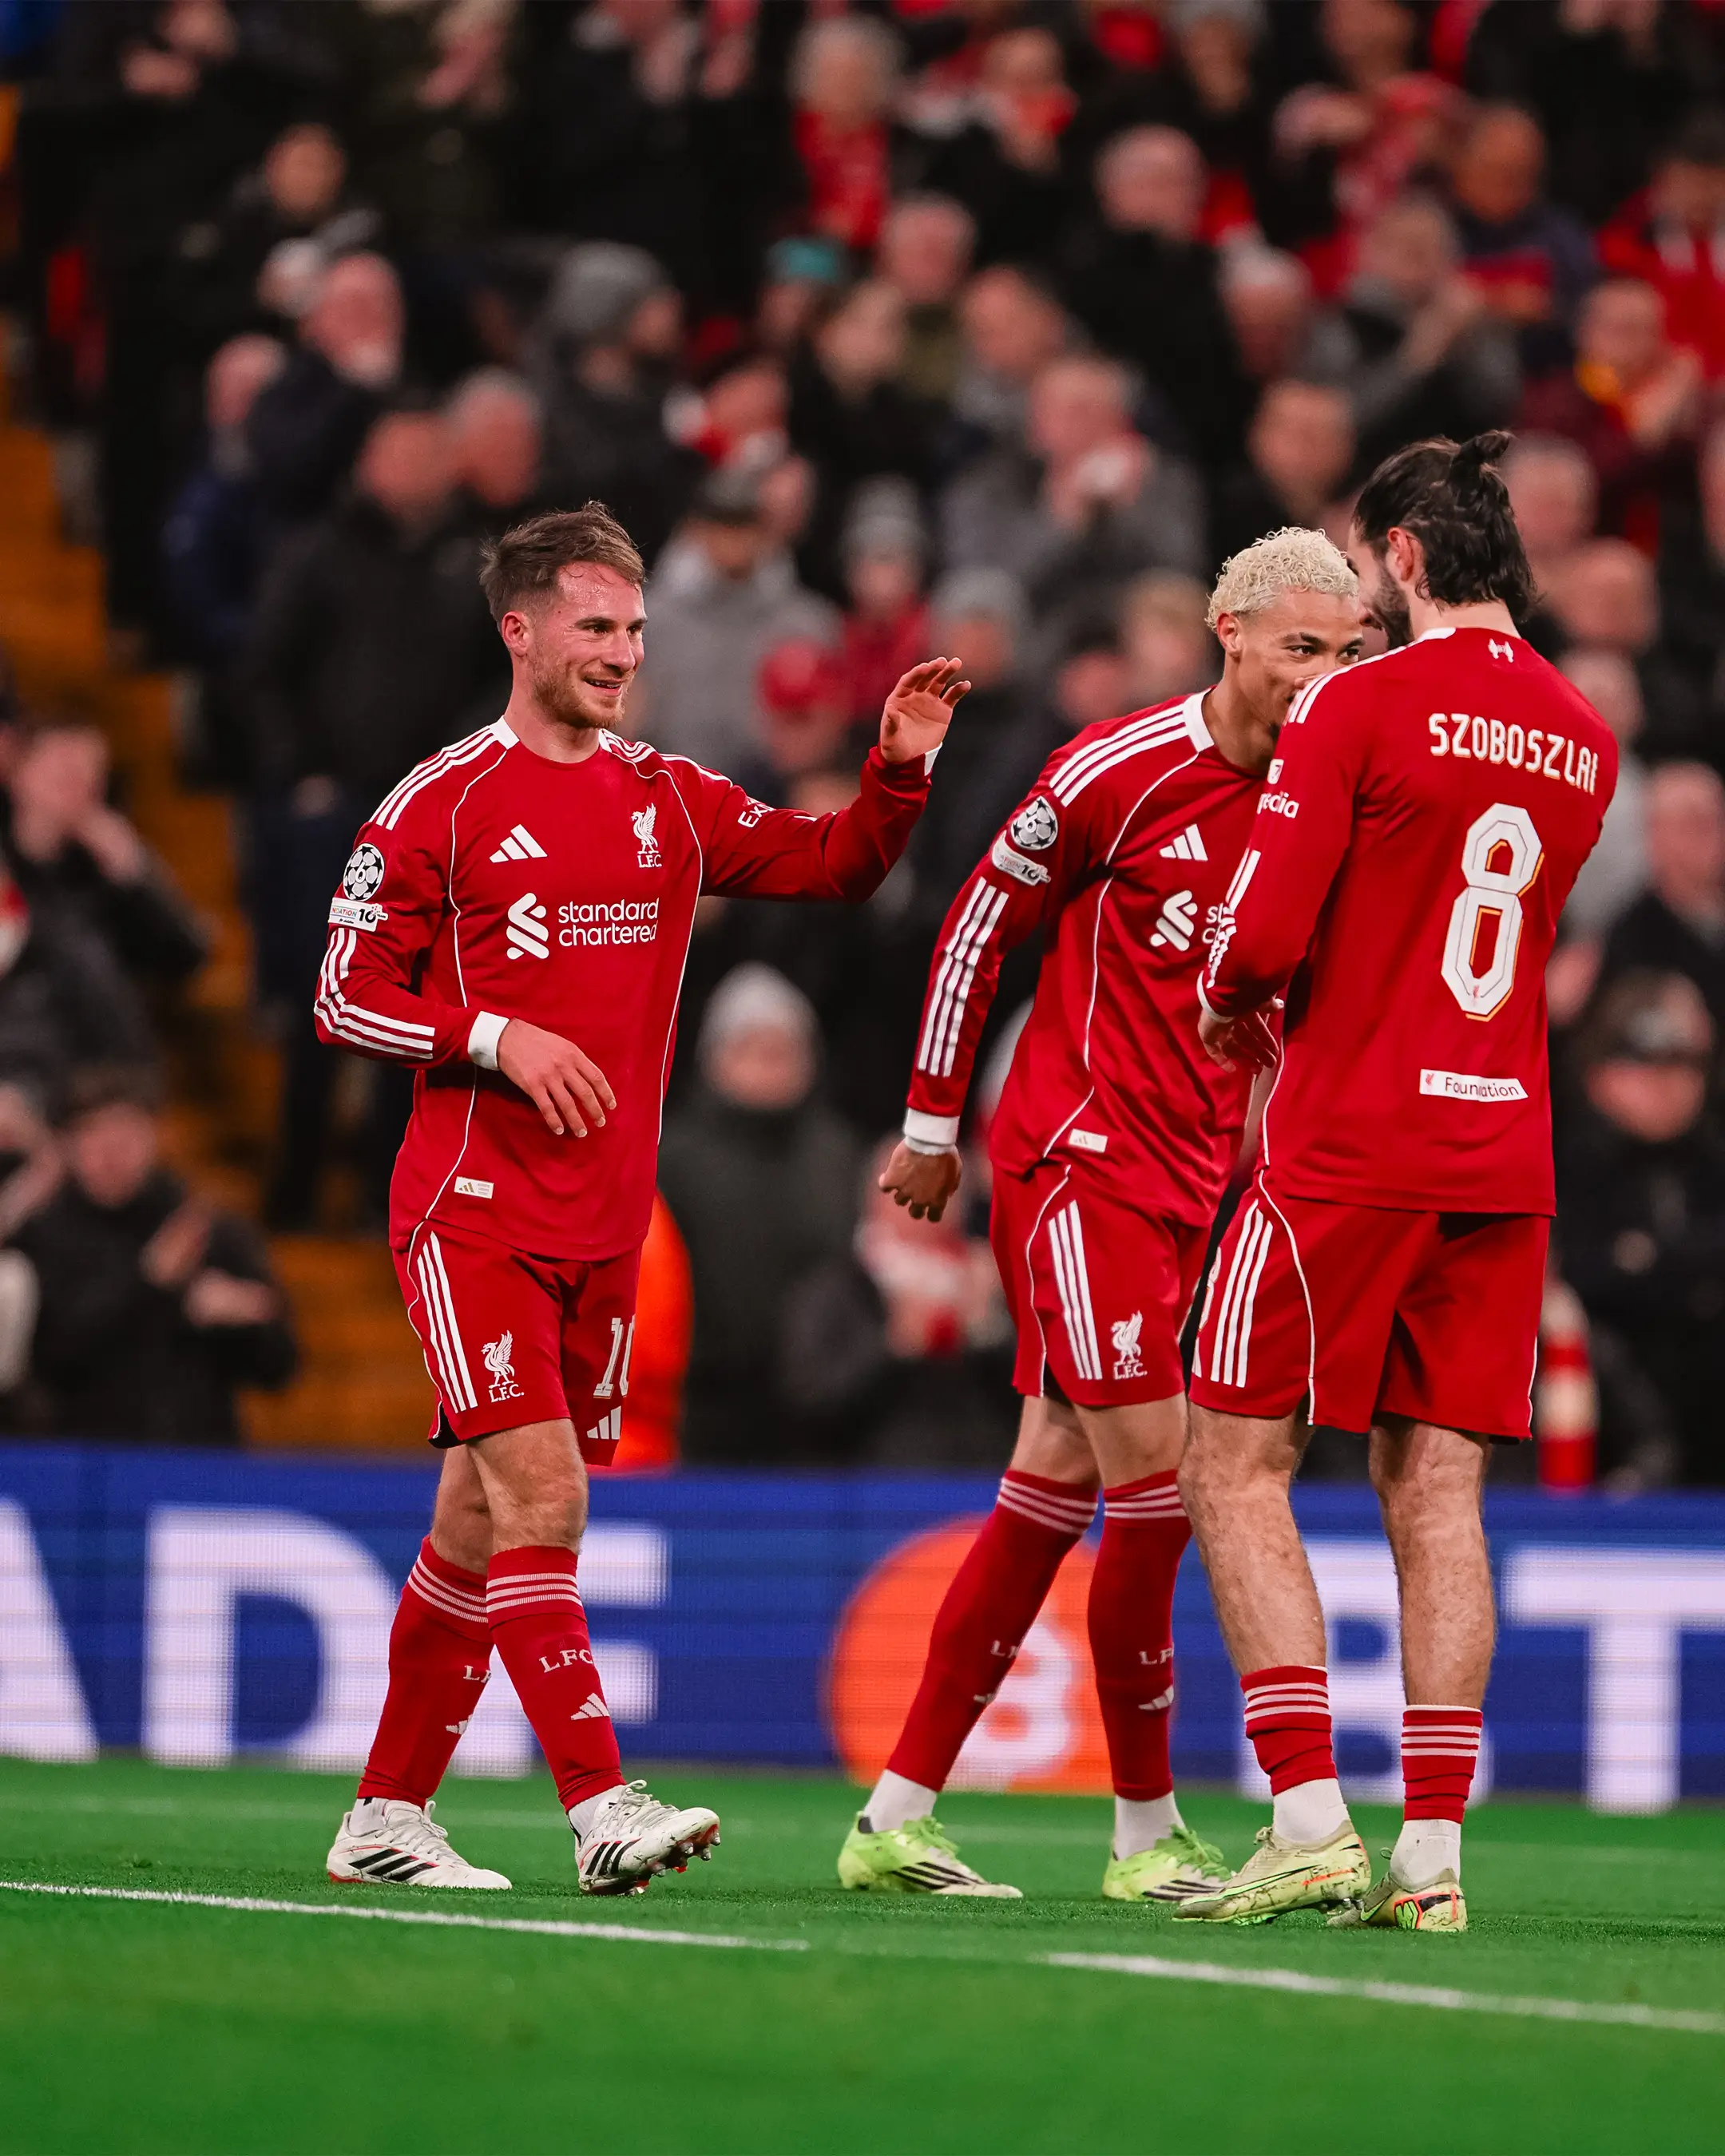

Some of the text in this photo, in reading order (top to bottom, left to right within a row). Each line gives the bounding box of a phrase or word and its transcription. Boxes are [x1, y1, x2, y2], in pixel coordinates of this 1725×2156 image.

[1429, 713, 1598, 795] SZOBOSZLAI
[355, 862, 367, 883] 6
[558, 898, 660, 924] standard
[1441, 803, 1545, 1022] 8
[559, 920, 658, 946] chartered
[1445, 1076, 1520, 1097] Founation
[488, 1383, 525, 1403] L.F.C.
